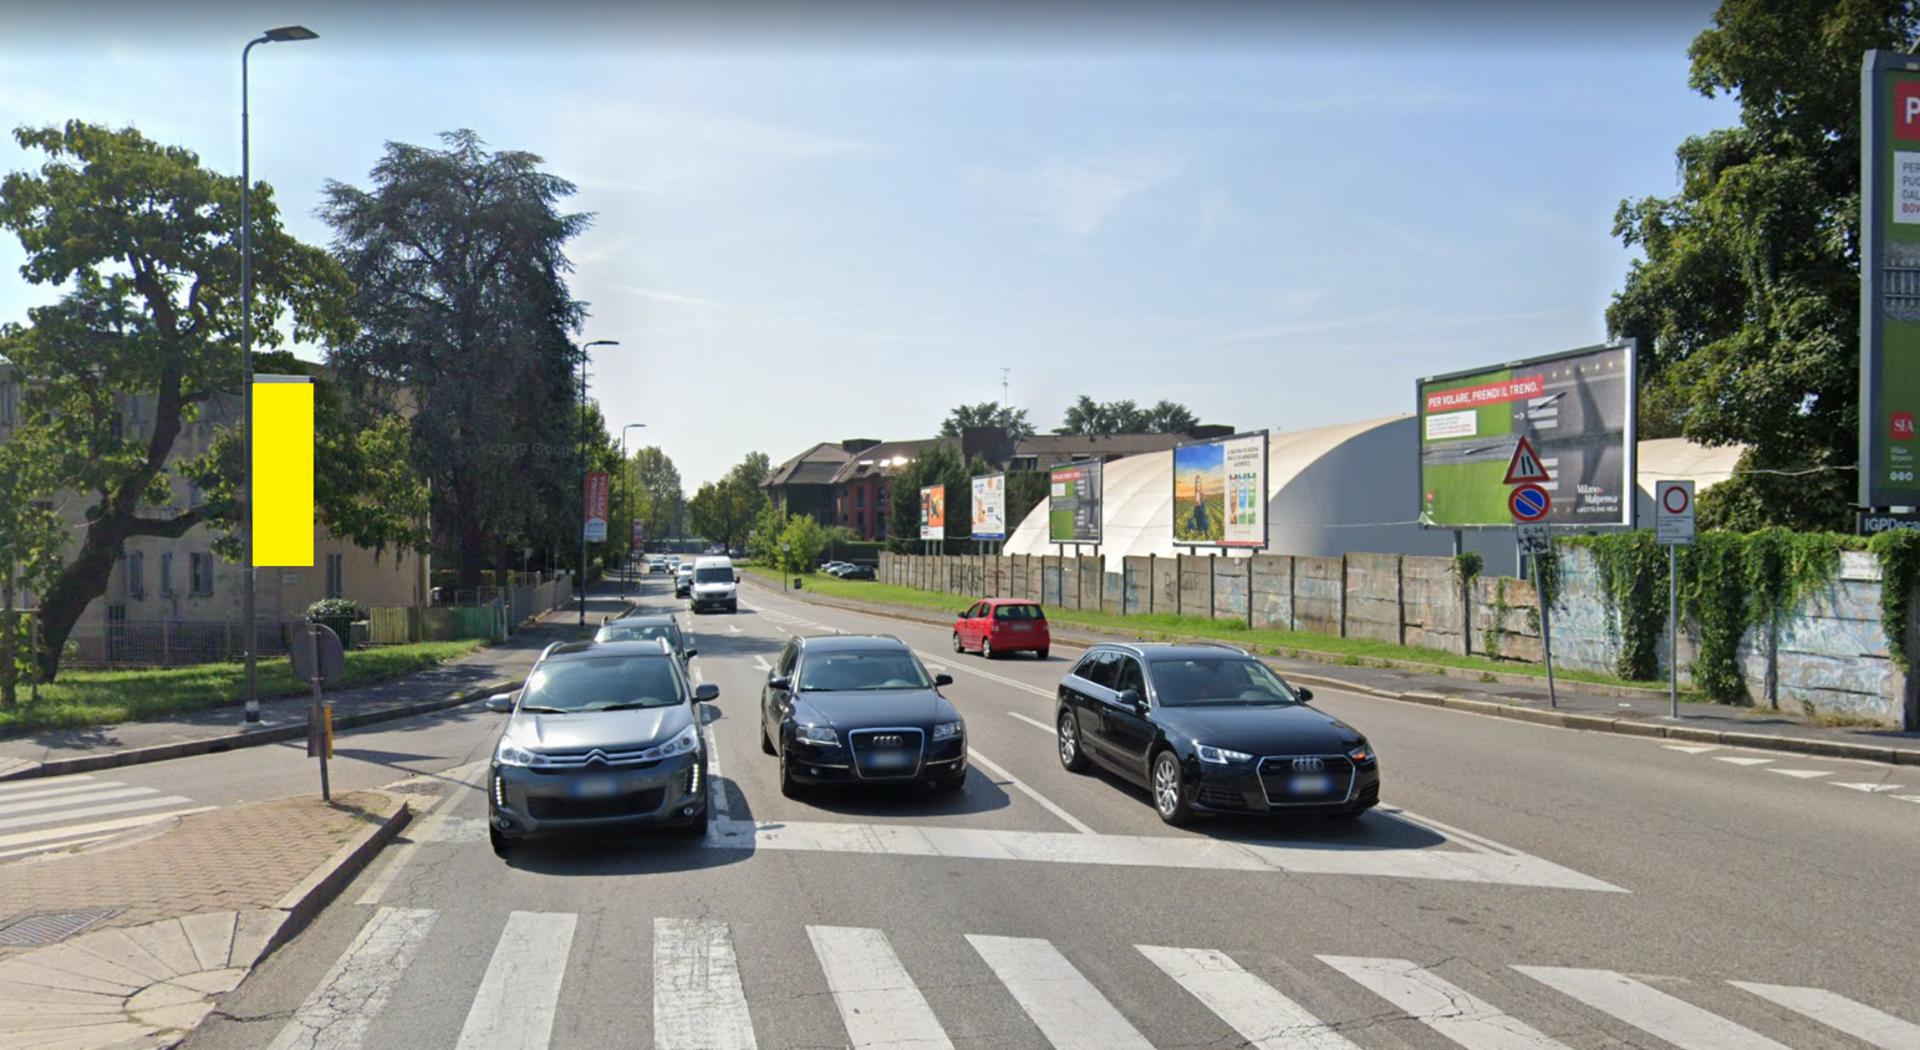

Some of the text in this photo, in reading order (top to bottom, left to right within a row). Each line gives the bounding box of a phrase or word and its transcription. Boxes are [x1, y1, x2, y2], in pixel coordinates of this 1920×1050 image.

[1428, 396, 1441, 408] PER
[1472, 388, 1500, 401] PRENDI
[1500, 388, 1508, 397] IL
[1894, 419, 1914, 432] SEA
